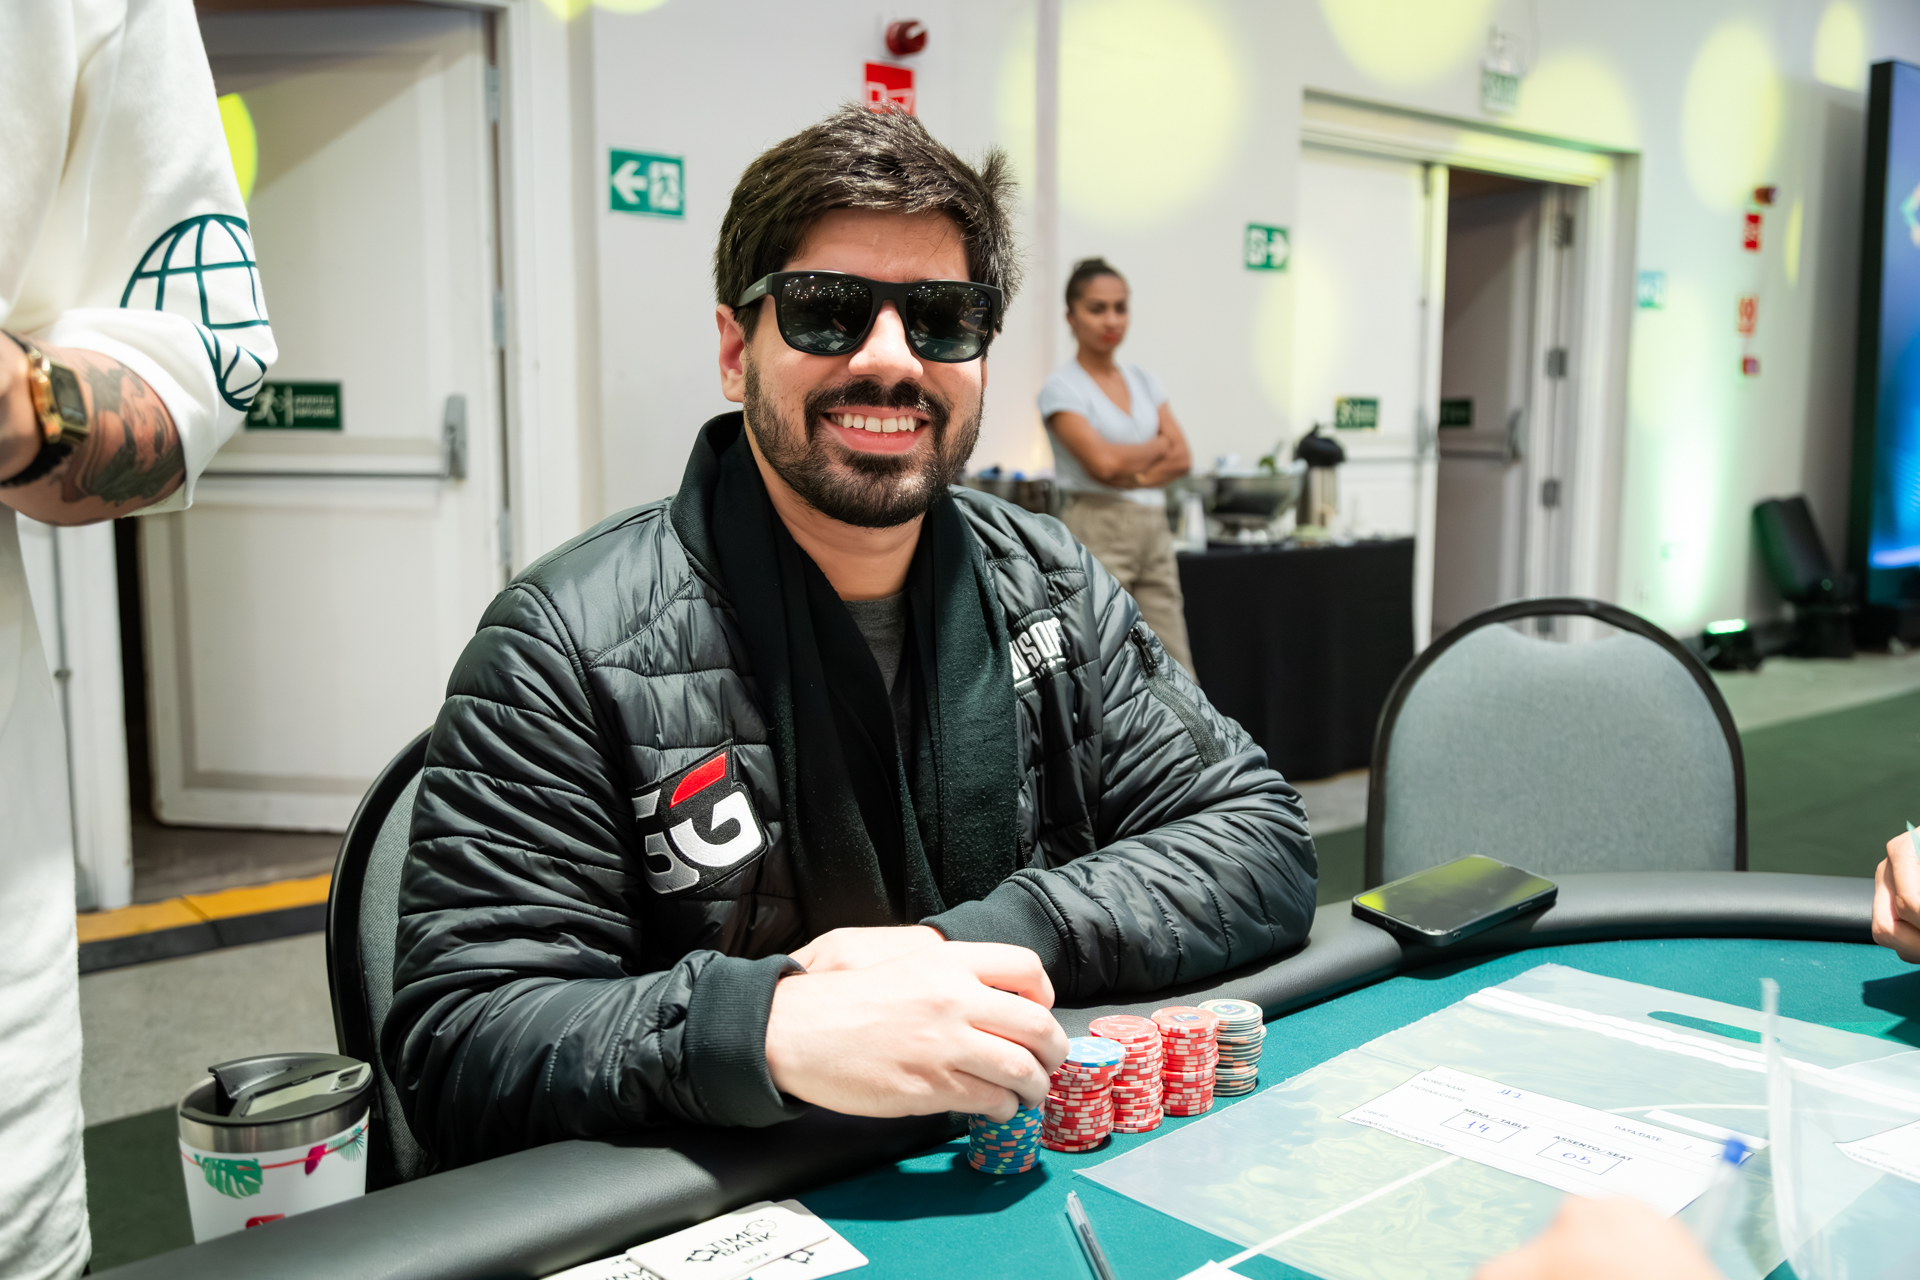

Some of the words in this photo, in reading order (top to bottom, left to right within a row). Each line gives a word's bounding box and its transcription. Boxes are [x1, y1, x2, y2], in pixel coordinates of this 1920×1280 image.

[1562, 1152, 1592, 1165] 05
[706, 1229, 759, 1249] TIME
[721, 1232, 777, 1256] BANK
